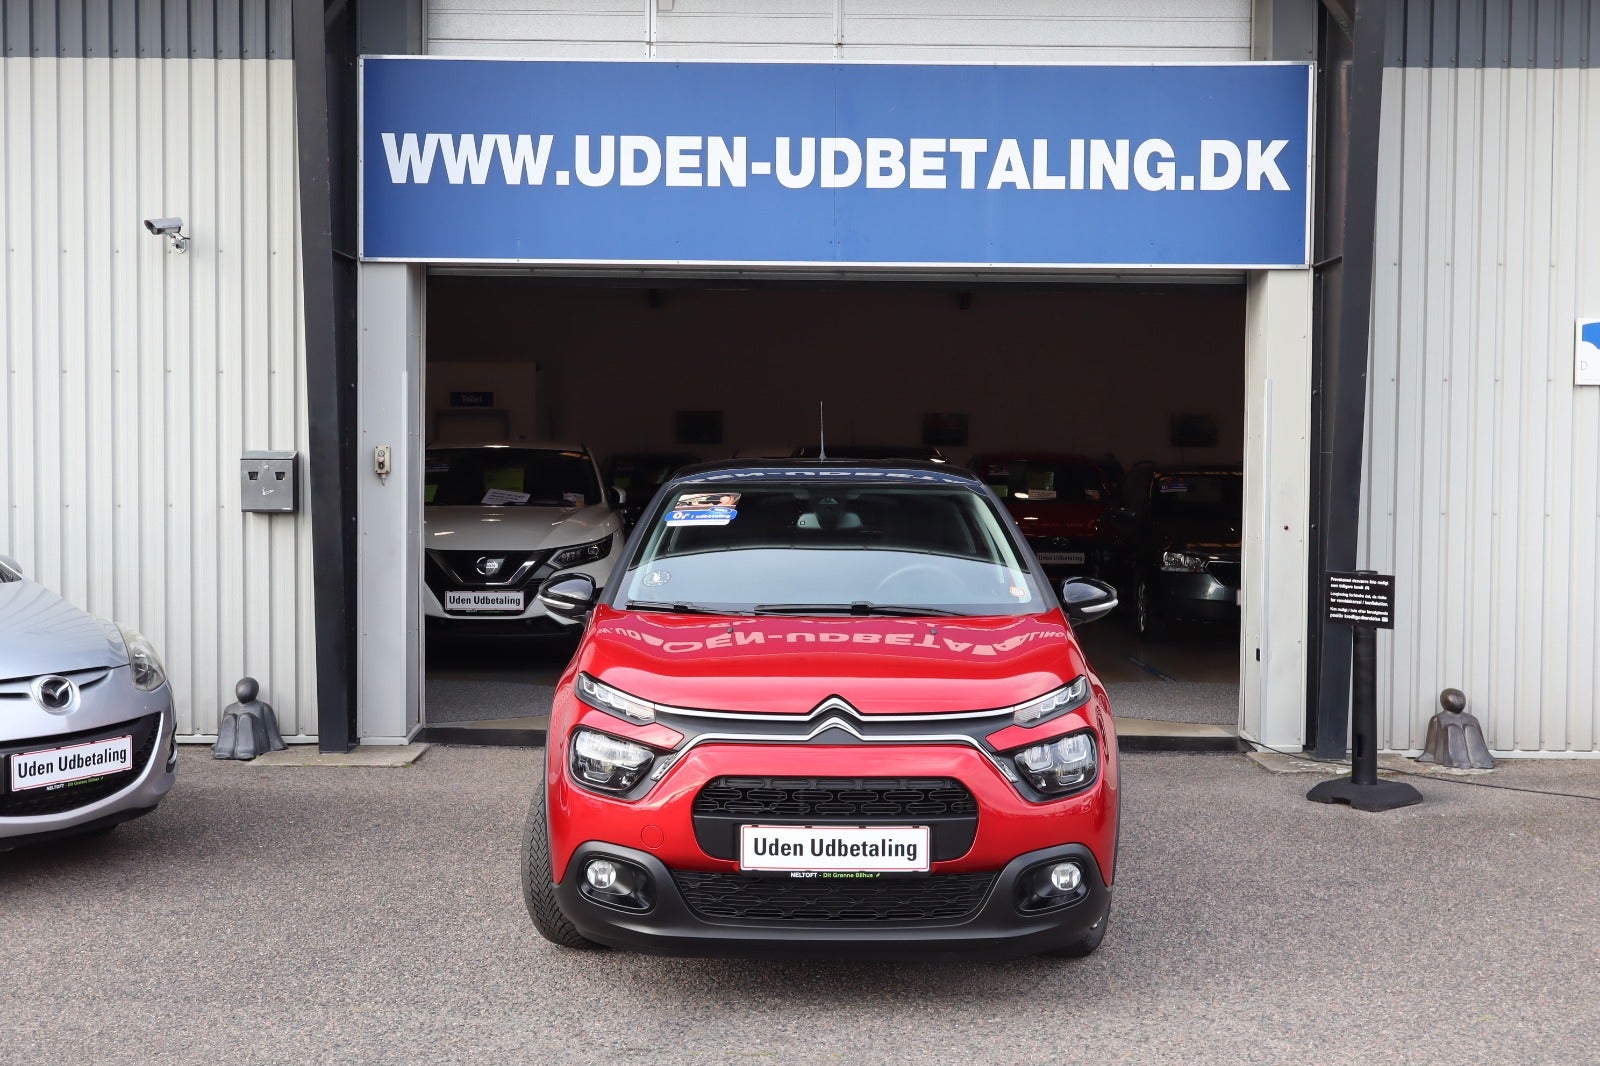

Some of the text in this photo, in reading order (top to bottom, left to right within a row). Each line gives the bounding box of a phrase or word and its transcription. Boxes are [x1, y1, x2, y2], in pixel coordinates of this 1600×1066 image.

[381, 132, 1290, 192] WWW.UDEN-UDBETALING.DK
[449, 595, 521, 607] Uden Udbetaling
[18, 748, 127, 779] Uden Udbetaling
[753, 837, 917, 862] Uden Udbetaling
